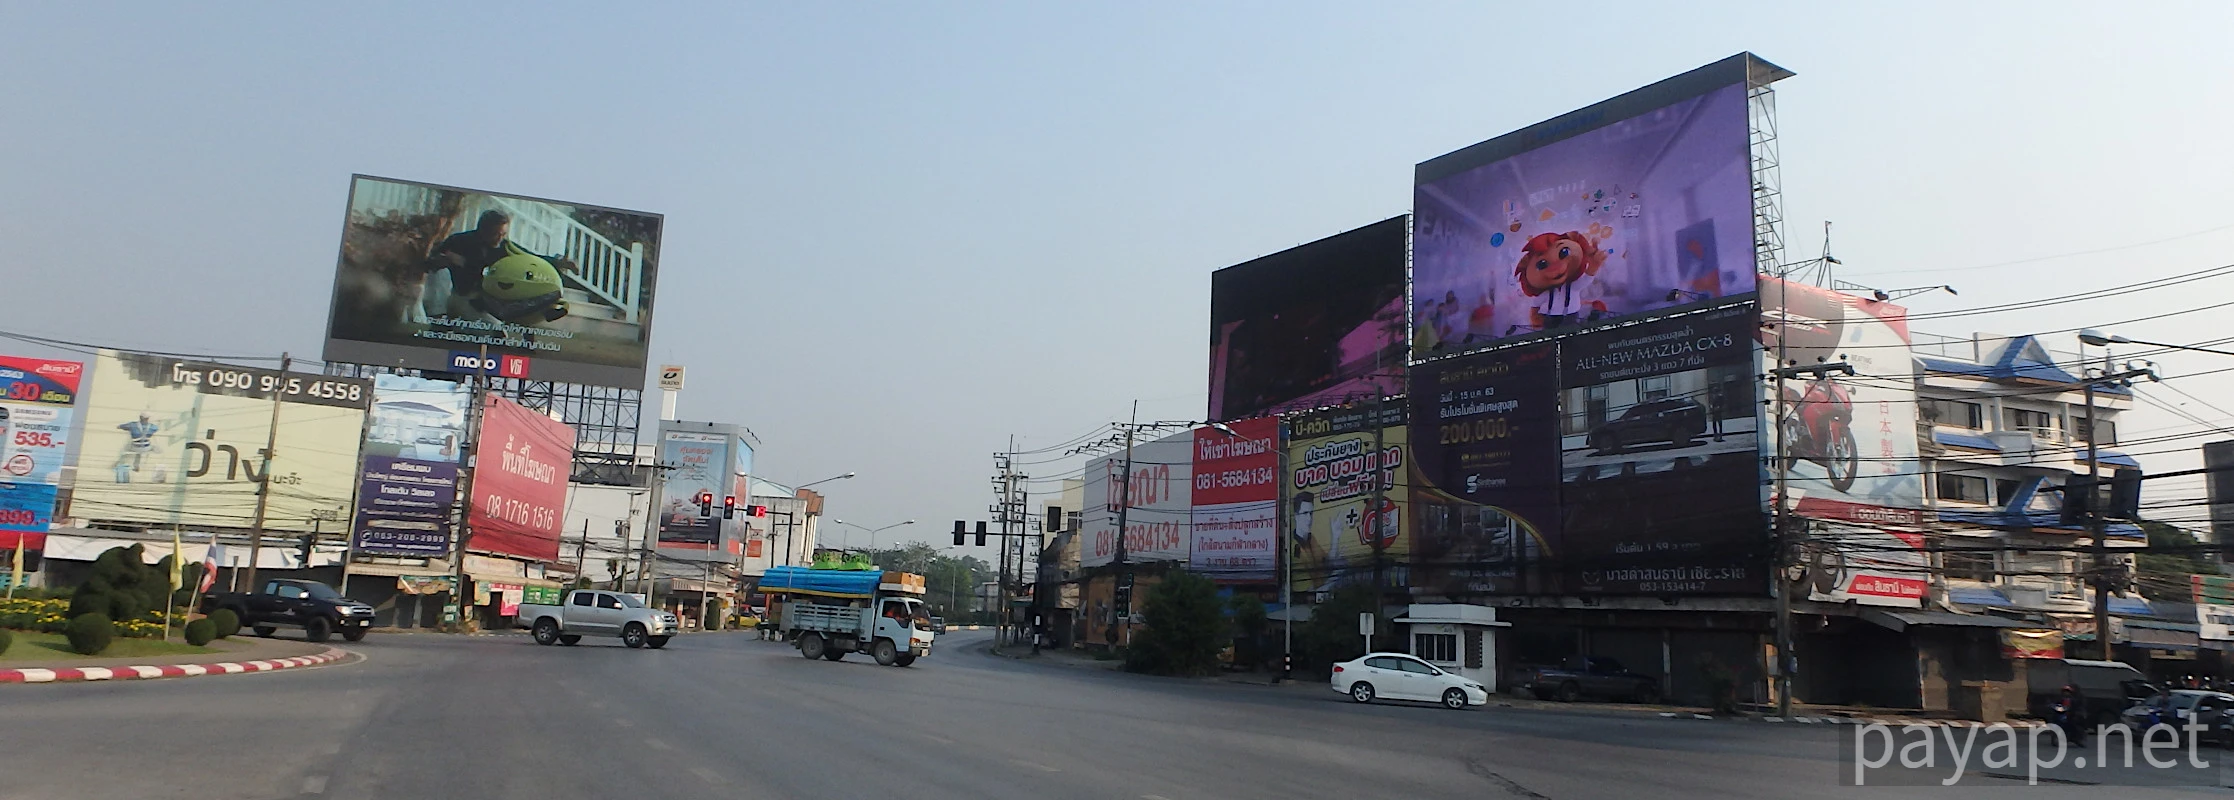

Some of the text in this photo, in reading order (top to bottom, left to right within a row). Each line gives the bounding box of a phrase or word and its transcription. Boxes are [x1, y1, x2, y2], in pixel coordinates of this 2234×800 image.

[1575, 334, 1733, 372] ALL-NEW MAZDA CX-8
[1653, 363, 1659, 371] 3
[1679, 359, 1685, 367] 7
[8, 382, 42, 400] 30
[173, 363, 202, 384] โทร
[209, 370, 252, 389] 090
[308, 380, 361, 401] 4558
[1485, 387, 1495, 396] 63
[1295, 418, 1330, 436] บี-ควิก
[1440, 417, 1519, 445] 200,000.-
[15, 431, 65, 448] 535.-
[1199, 437, 1271, 461] ให้เช่าโฆษณา
[185, 429, 275, 483] ว่าง
[502, 434, 556, 485] พื้นที่โฆษณา
[1306, 440, 1360, 464] ประกันยาง
[1196, 467, 1273, 490] 081-5684134
[1296, 463, 1327, 488] บาด
[1331, 456, 1364, 479] บวม
[486, 494, 554, 531] 08 1716 1516
